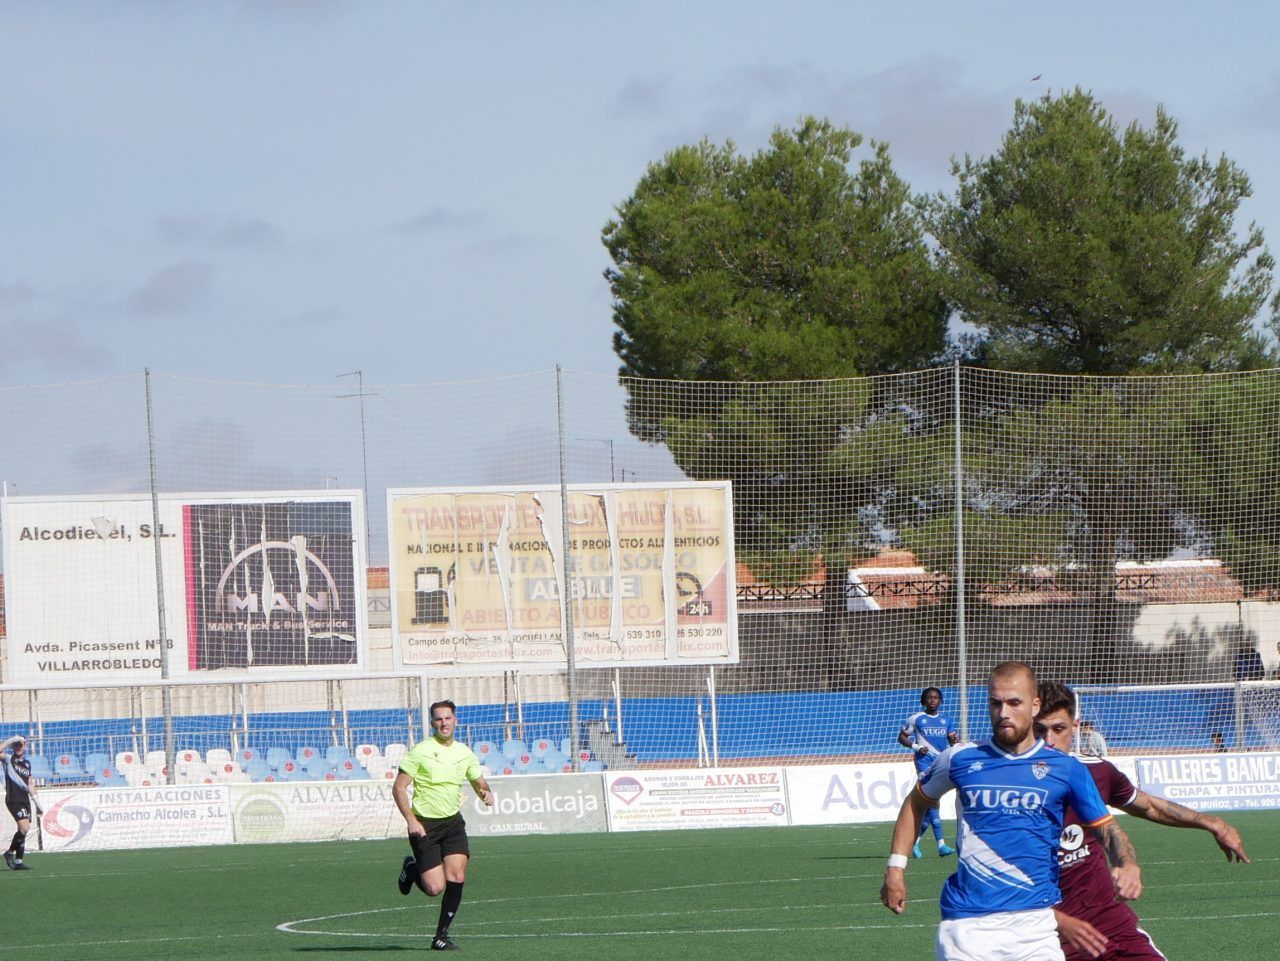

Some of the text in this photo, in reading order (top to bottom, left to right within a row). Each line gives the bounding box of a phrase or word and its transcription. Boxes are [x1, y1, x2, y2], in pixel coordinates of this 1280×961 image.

[582, 538, 644, 550] PRODCTOS
[647, 536, 720, 549] ALIENTICIOS
[226, 591, 329, 613] MAN
[207, 622, 234, 632] MAN
[307, 619, 349, 629] Service
[24, 642, 64, 654] Avda.
[69, 640, 141, 652] Picassent
[408, 637, 437, 647] Campo
[37, 658, 163, 672] VILLARROBLEDO
[922, 728, 946, 736] YUGO
[1141, 758, 1222, 785] TALLERES
[704, 772, 780, 787] ALVAREZ
[99, 789, 221, 804] INSTALACIONES
[1169, 783, 1280, 797] CHAPA Y PINTURA
[474, 789, 599, 819] Globalcaja
[965, 789, 1042, 810] YUGO
[98, 808, 151, 823] Camacho
[154, 807, 197, 821] Alcolea
[207, 806, 227, 819] S.L.
[489, 821, 546, 833] CAJA RURAL
[1057, 844, 1091, 865] Coral
